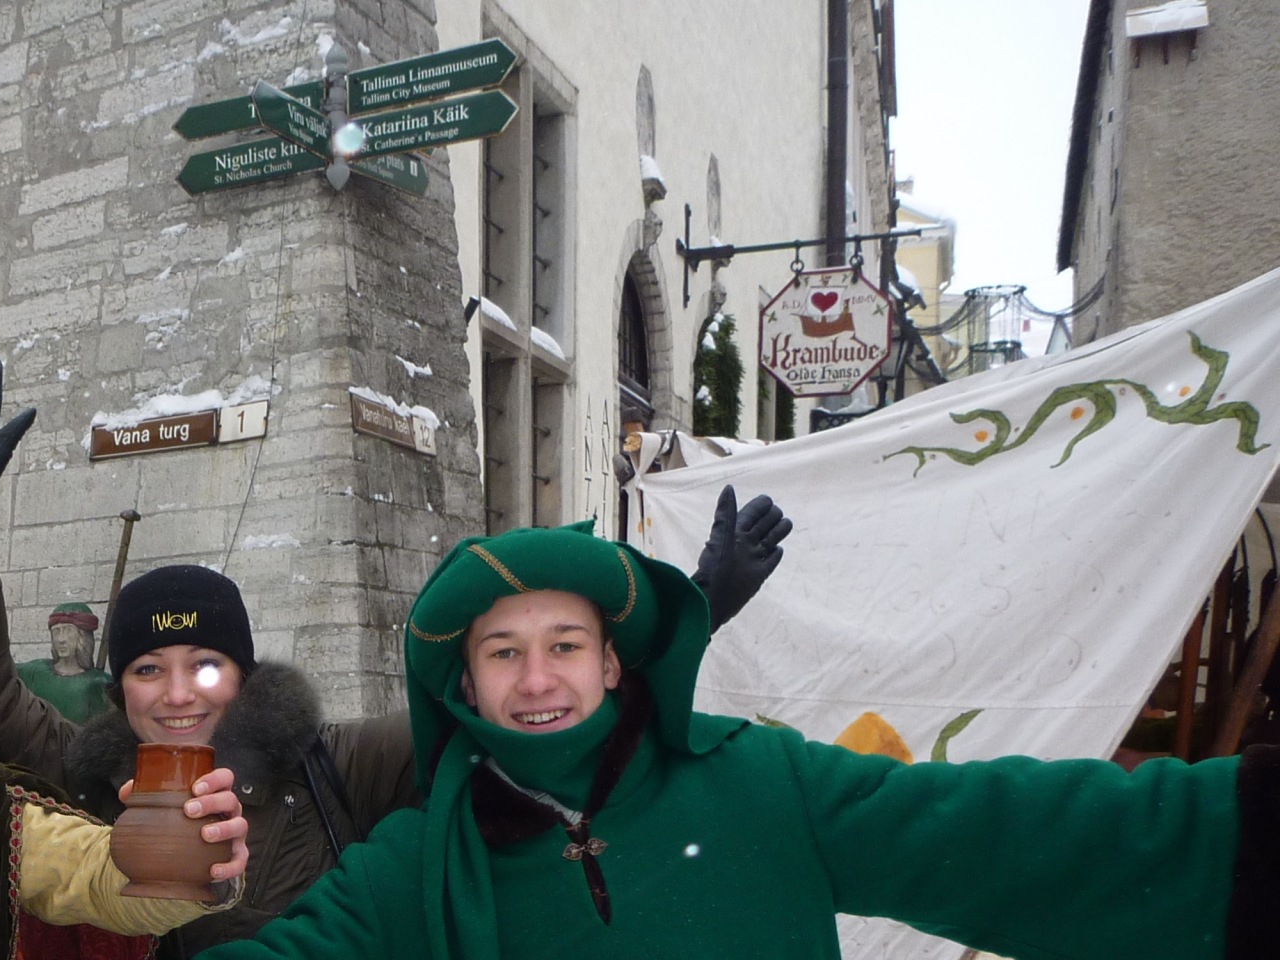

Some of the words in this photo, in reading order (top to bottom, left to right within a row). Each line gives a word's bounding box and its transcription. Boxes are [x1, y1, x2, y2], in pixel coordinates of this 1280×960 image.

[361, 74, 406, 93] Tallinna
[409, 53, 498, 82] Linnamuuseum
[361, 89, 391, 106] Tallinn
[392, 86, 411, 100] City
[413, 79, 450, 94] Museum
[287, 103, 305, 126] Viru
[362, 114, 429, 140] Katariina
[433, 104, 469, 125] Käik
[425, 126, 460, 143] Passage
[214, 146, 277, 171] Niguliste
[214, 175, 224, 185] St.
[226, 166, 261, 182] Nicholas
[263, 160, 293, 175] Church
[770, 333, 881, 371] Krambude
[786, 366, 817, 381] Olde
[237, 410, 246, 433] 1
[113, 428, 150, 446] Vana
[159, 423, 190, 441] turg
[419, 424, 432, 448] 12
